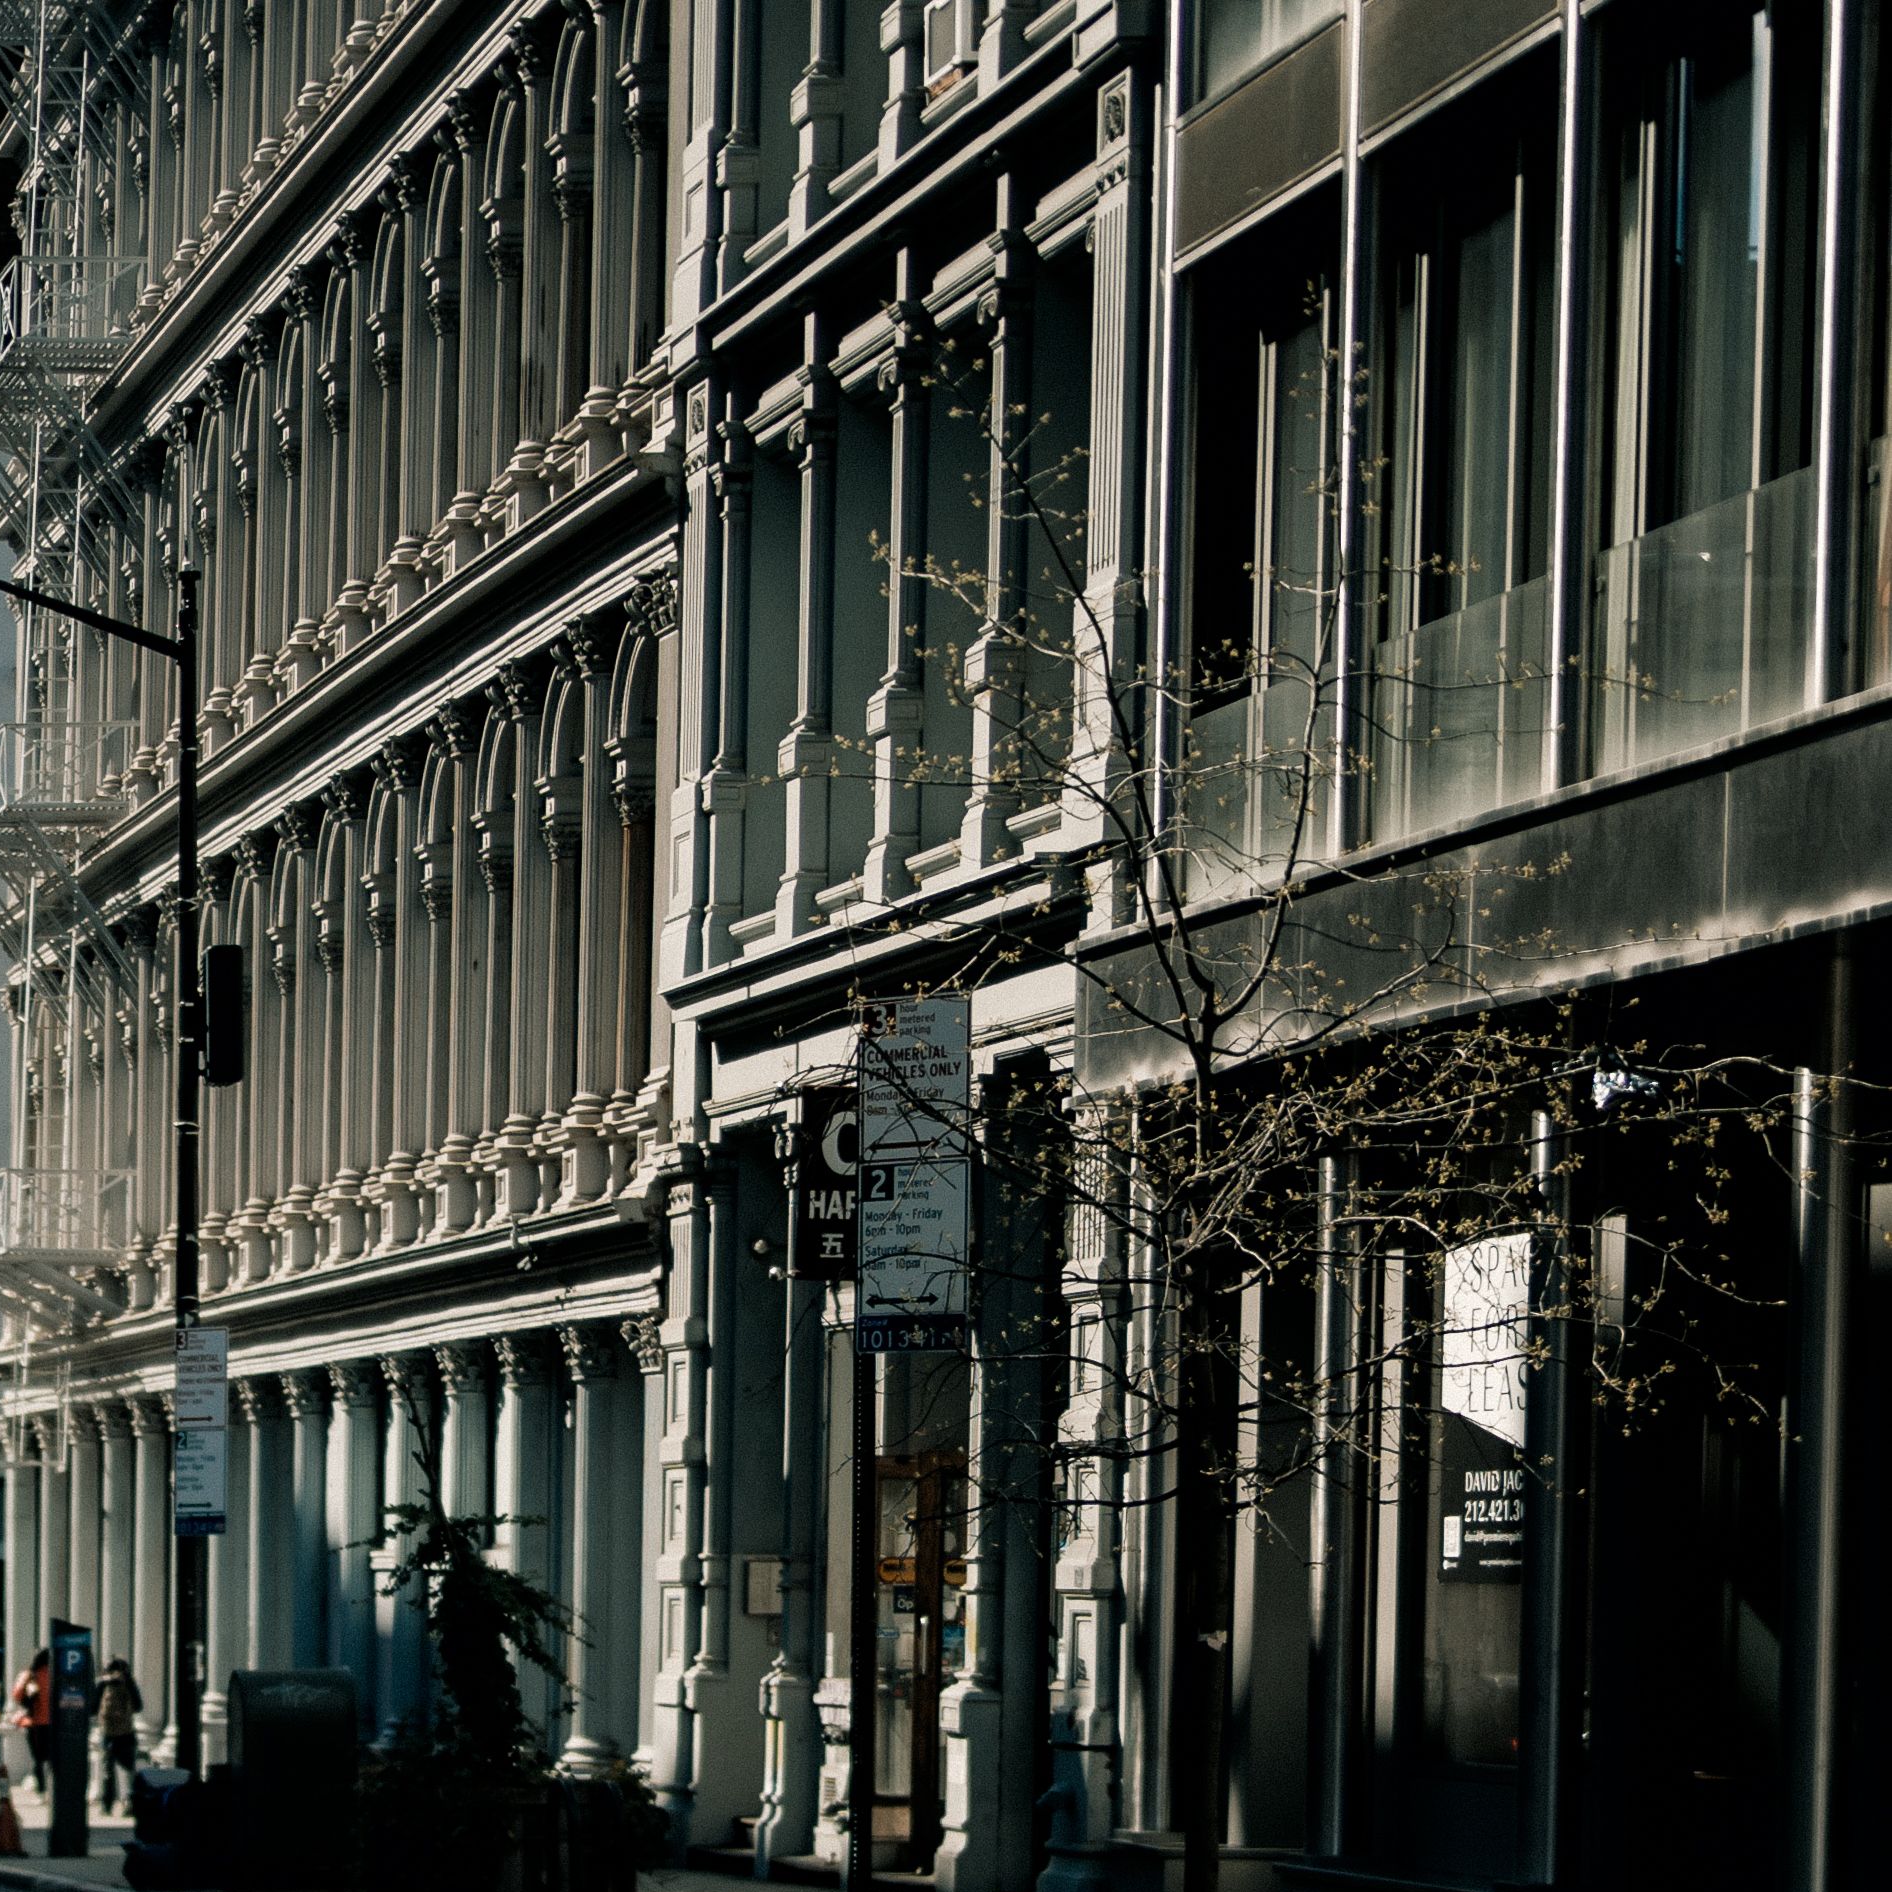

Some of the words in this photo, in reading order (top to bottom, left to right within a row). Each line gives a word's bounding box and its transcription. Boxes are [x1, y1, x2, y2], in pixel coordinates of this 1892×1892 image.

[871, 1005, 887, 1034] 3
[900, 1013, 935, 1023] metered
[899, 1025, 931, 1037] parking
[867, 1045, 948, 1063] COMMERCIAL
[867, 1064, 925, 1081] VEHICLES
[929, 1061, 961, 1076] ONLY
[870, 1169, 886, 1199] 2
[865, 1210, 903, 1223] Monday
[912, 1208, 943, 1220] Friday
[895, 1224, 921, 1236] 10pm
[865, 1245, 908, 1257] Saturday
[1471, 1304, 1517, 1352] FOR
[1465, 1470, 1500, 1492] DAVID
[67, 1650, 81, 1671] P
